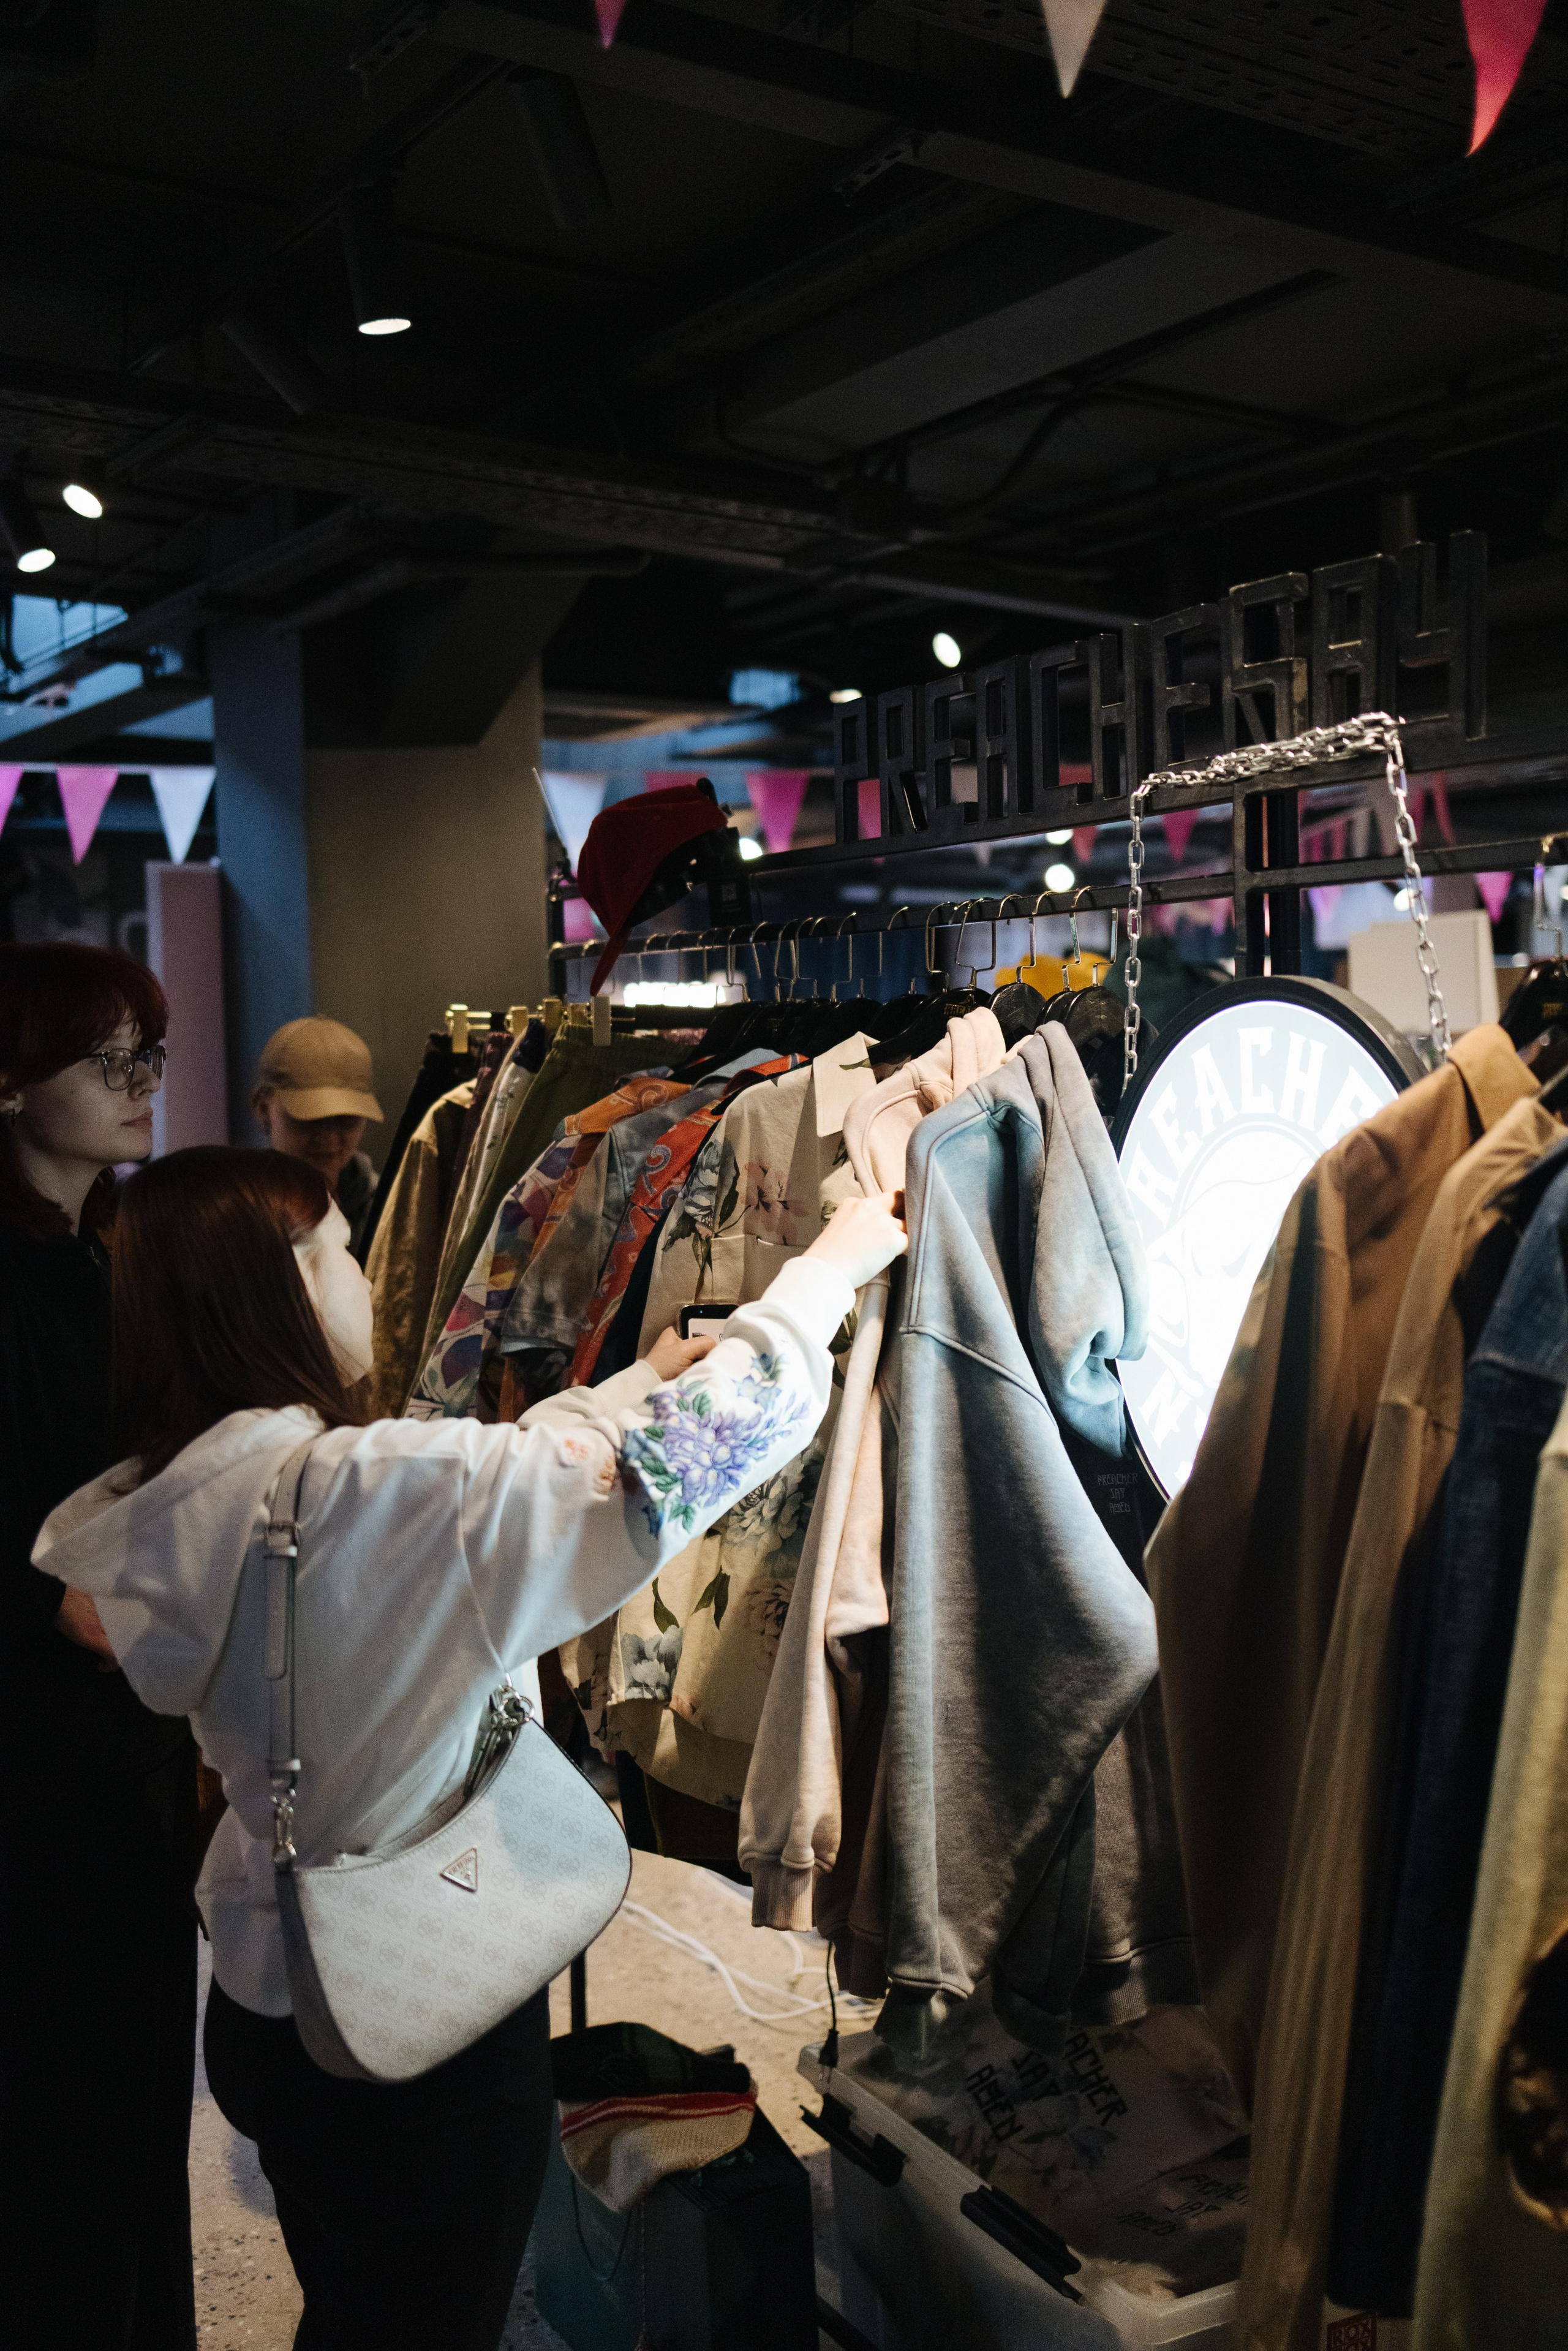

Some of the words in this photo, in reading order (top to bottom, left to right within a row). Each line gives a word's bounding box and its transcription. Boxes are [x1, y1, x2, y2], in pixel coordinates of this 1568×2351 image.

[1126, 1026, 1384, 1230] REACHE
[1097, 1473, 1138, 1486] PREACHER
[1110, 1487, 1126, 1500] SAY
[1063, 2027, 1128, 2127] ACHER
